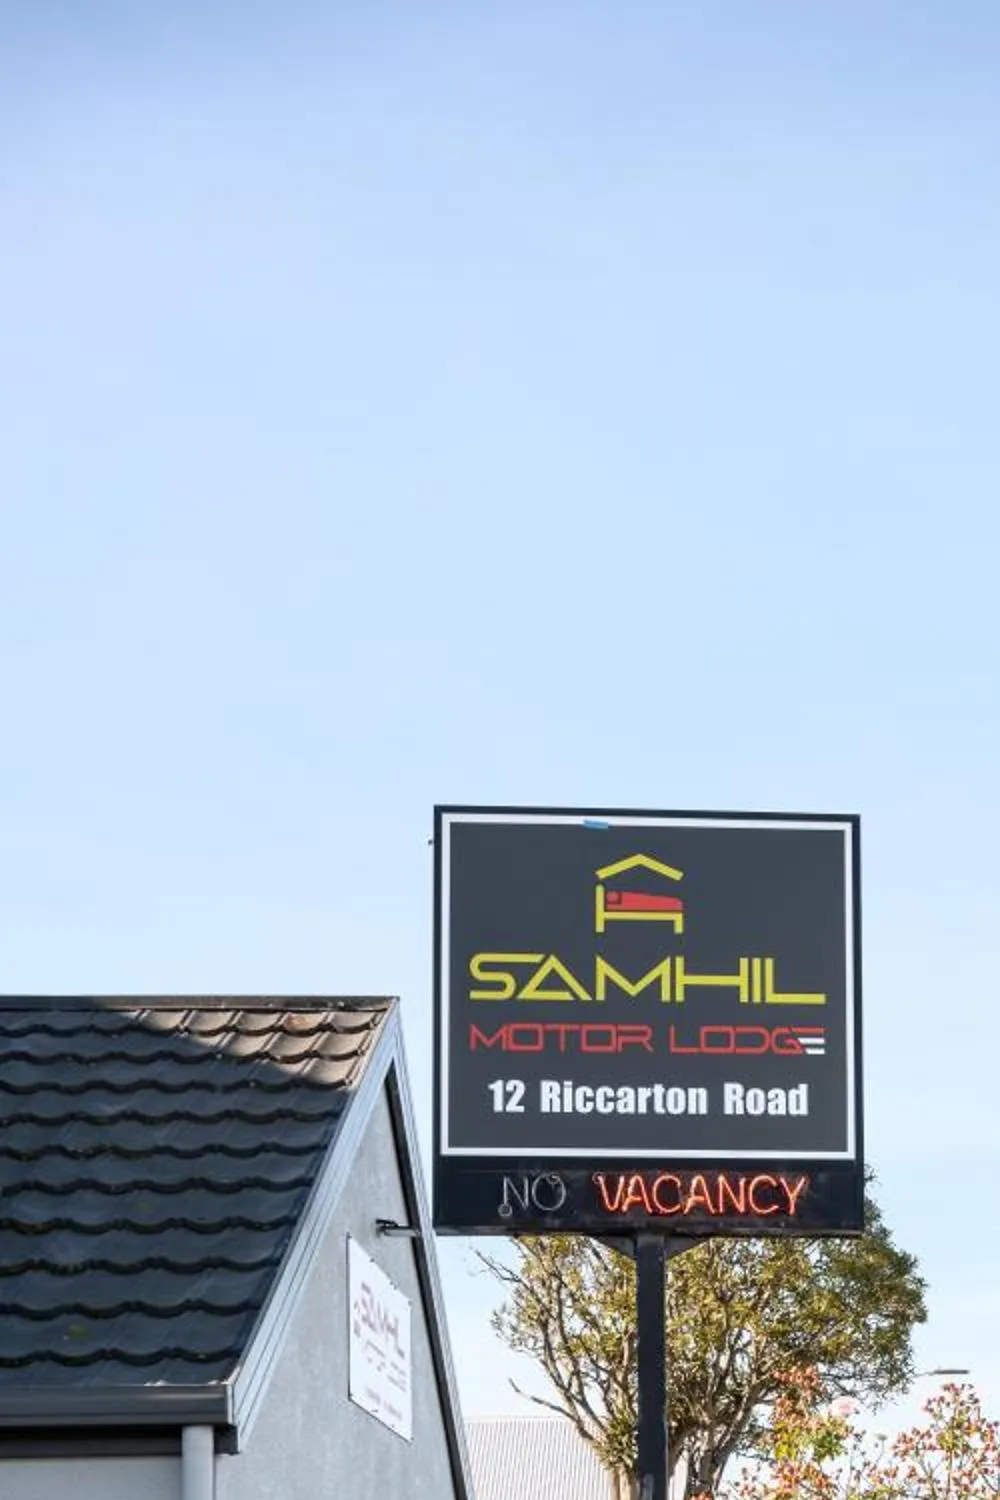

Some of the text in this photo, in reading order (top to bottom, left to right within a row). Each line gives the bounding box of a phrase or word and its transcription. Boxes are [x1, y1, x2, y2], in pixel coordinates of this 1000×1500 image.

[469, 953, 826, 1004] SAMHIL
[470, 1023, 825, 1055] MOTOR LODGE
[488, 1080, 808, 1116] 12 Riccarton Road
[501, 1173, 808, 1214] NO VACANCY
